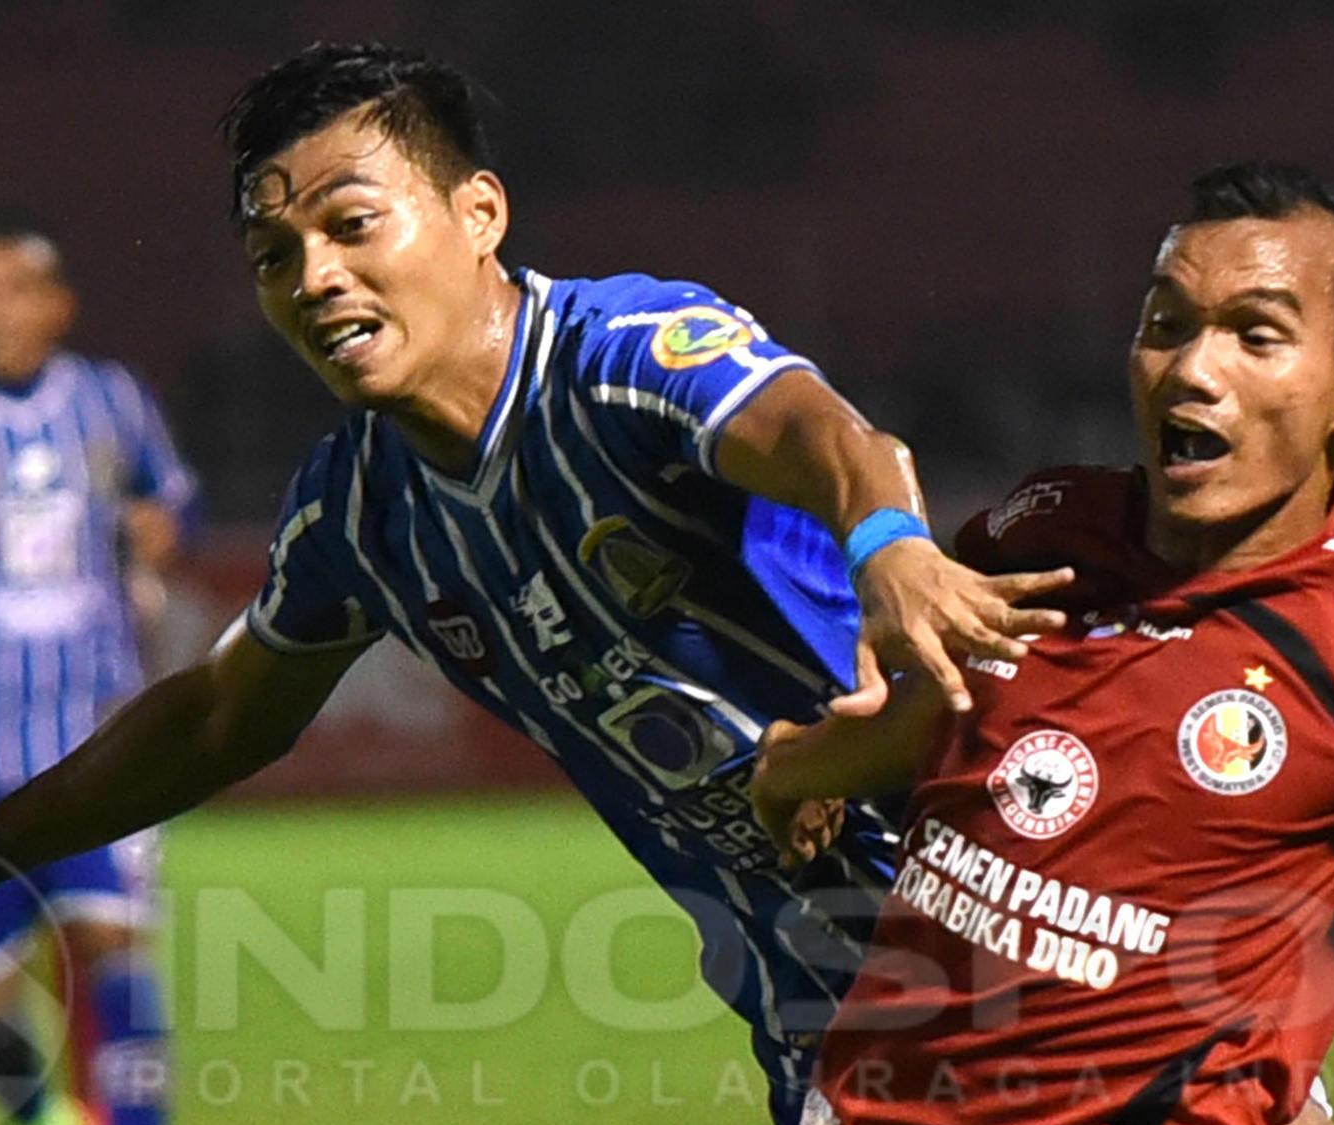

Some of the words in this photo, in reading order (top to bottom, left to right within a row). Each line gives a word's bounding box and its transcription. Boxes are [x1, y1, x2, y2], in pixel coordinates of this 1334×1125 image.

[918, 818, 1015, 904] SEMEN
[1008, 868, 1171, 954] PADANG
[1026, 927, 1118, 990] DUO
